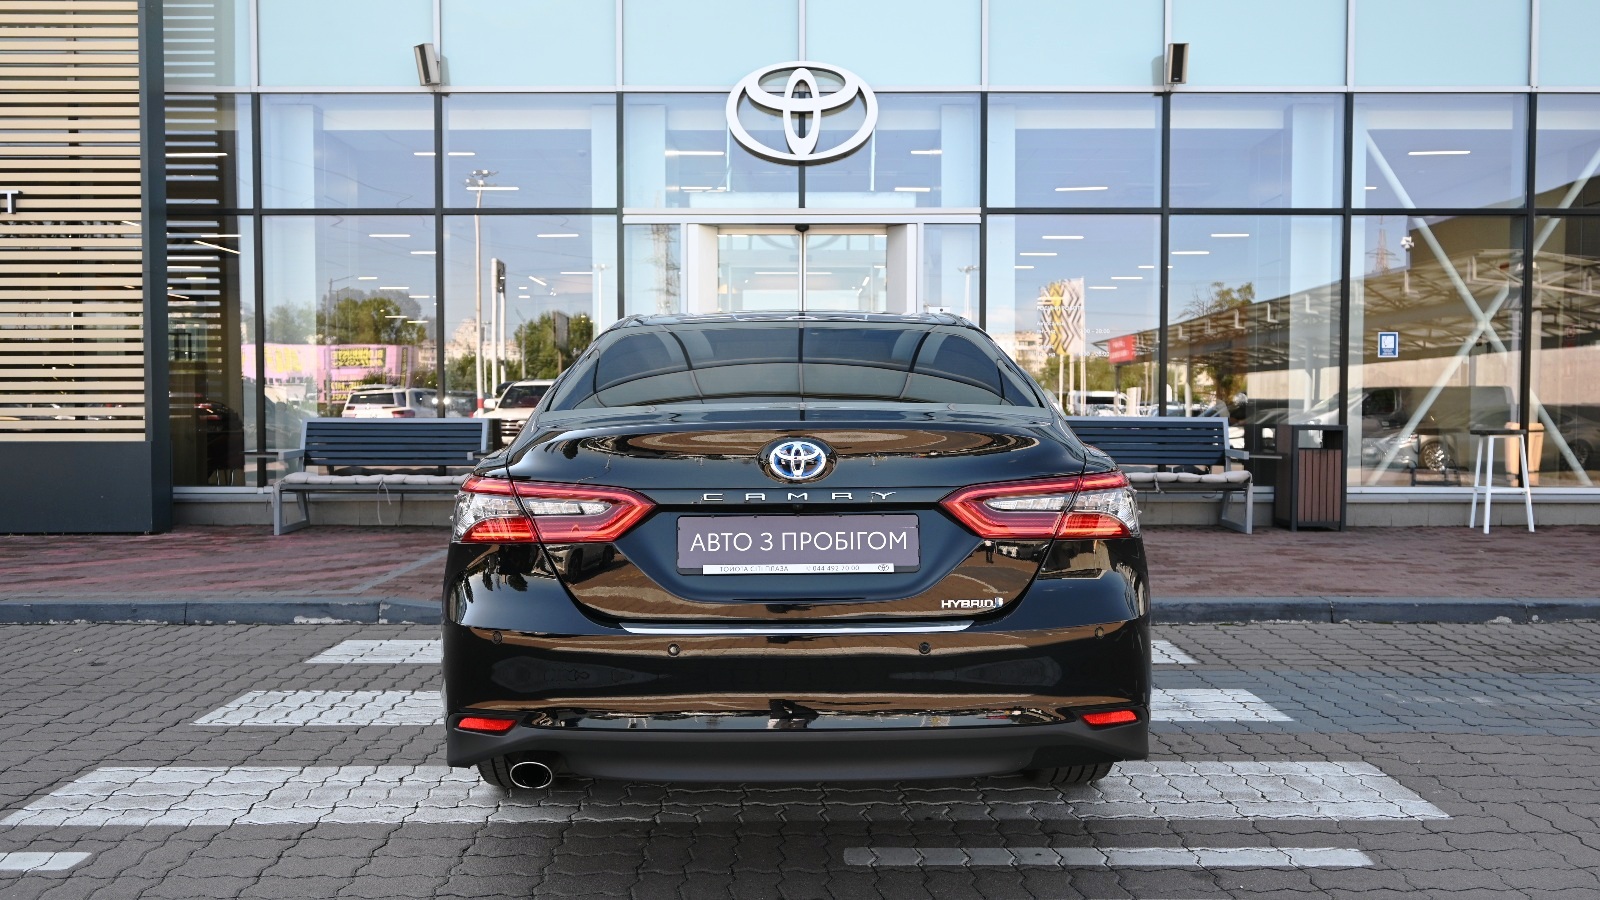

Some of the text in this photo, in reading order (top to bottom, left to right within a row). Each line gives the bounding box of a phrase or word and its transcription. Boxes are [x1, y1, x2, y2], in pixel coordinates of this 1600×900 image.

[703, 491, 897, 501] CAMRY
[689, 530, 908, 552] АВТО З ПРОБІГОМ
[941, 599, 993, 609] HYBRID
